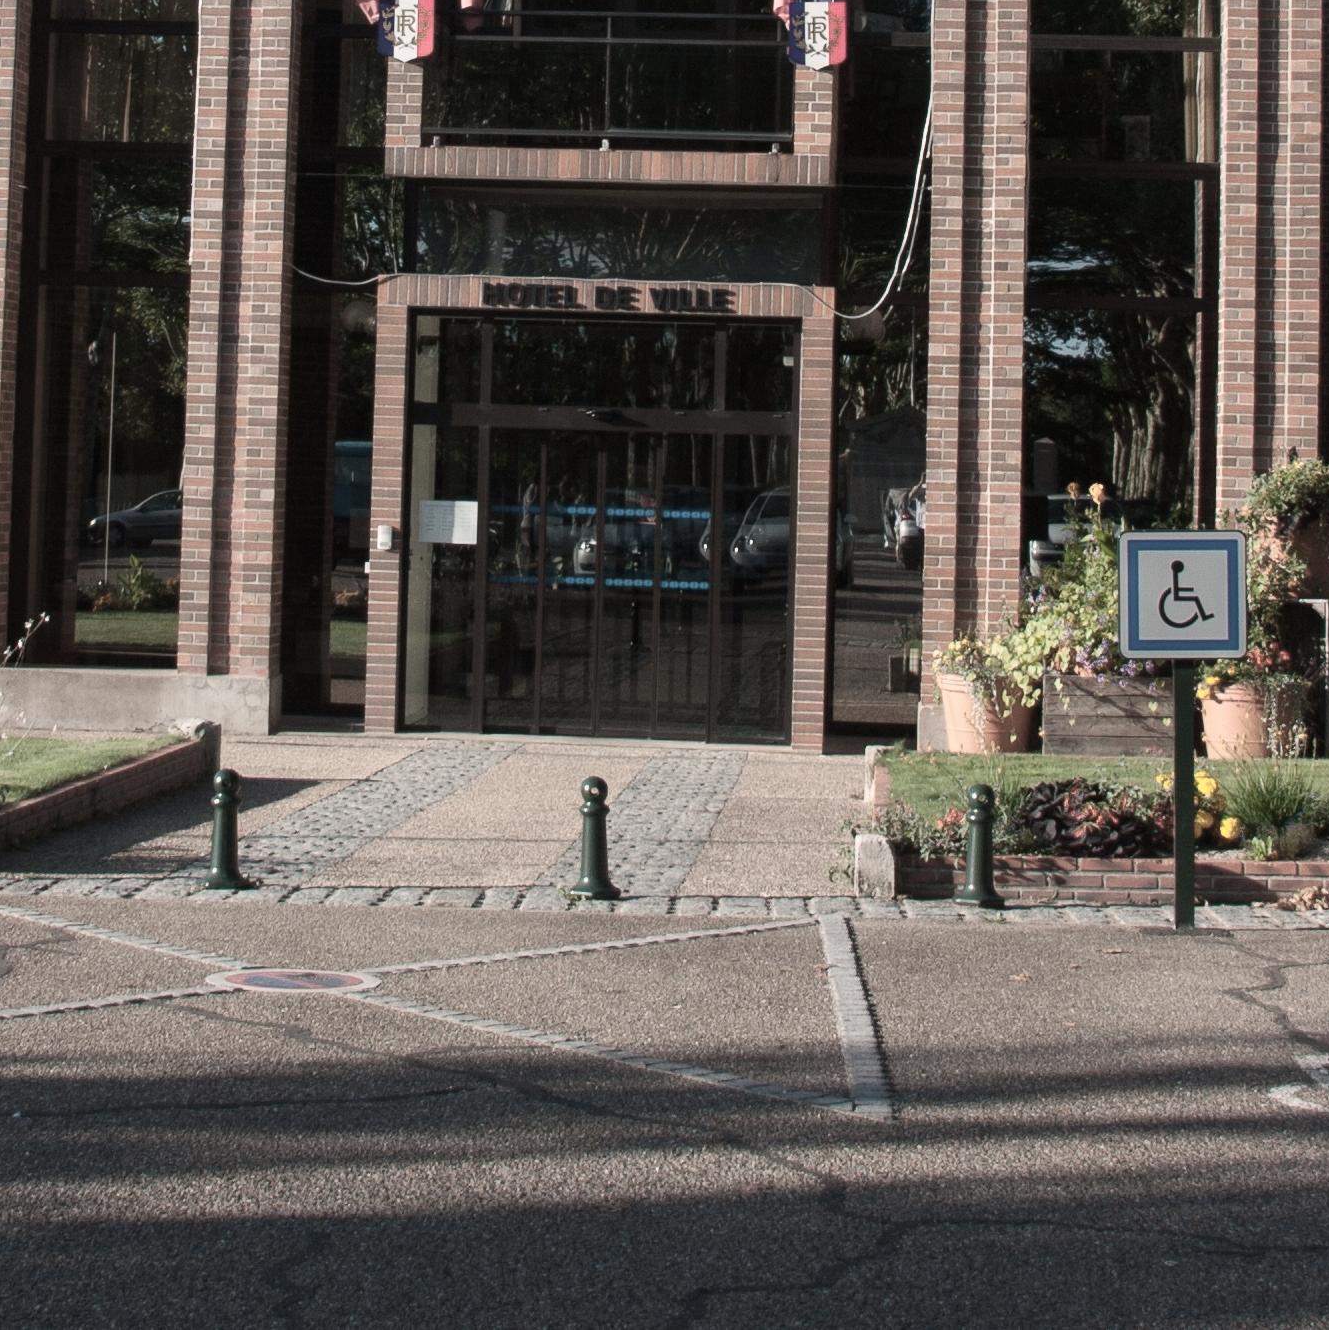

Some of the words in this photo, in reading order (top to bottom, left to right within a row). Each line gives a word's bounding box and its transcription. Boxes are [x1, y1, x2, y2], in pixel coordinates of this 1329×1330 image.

[482, 282, 587, 310] HOTEL
[594, 286, 642, 311] DE
[649, 287, 737, 314] VILLE
